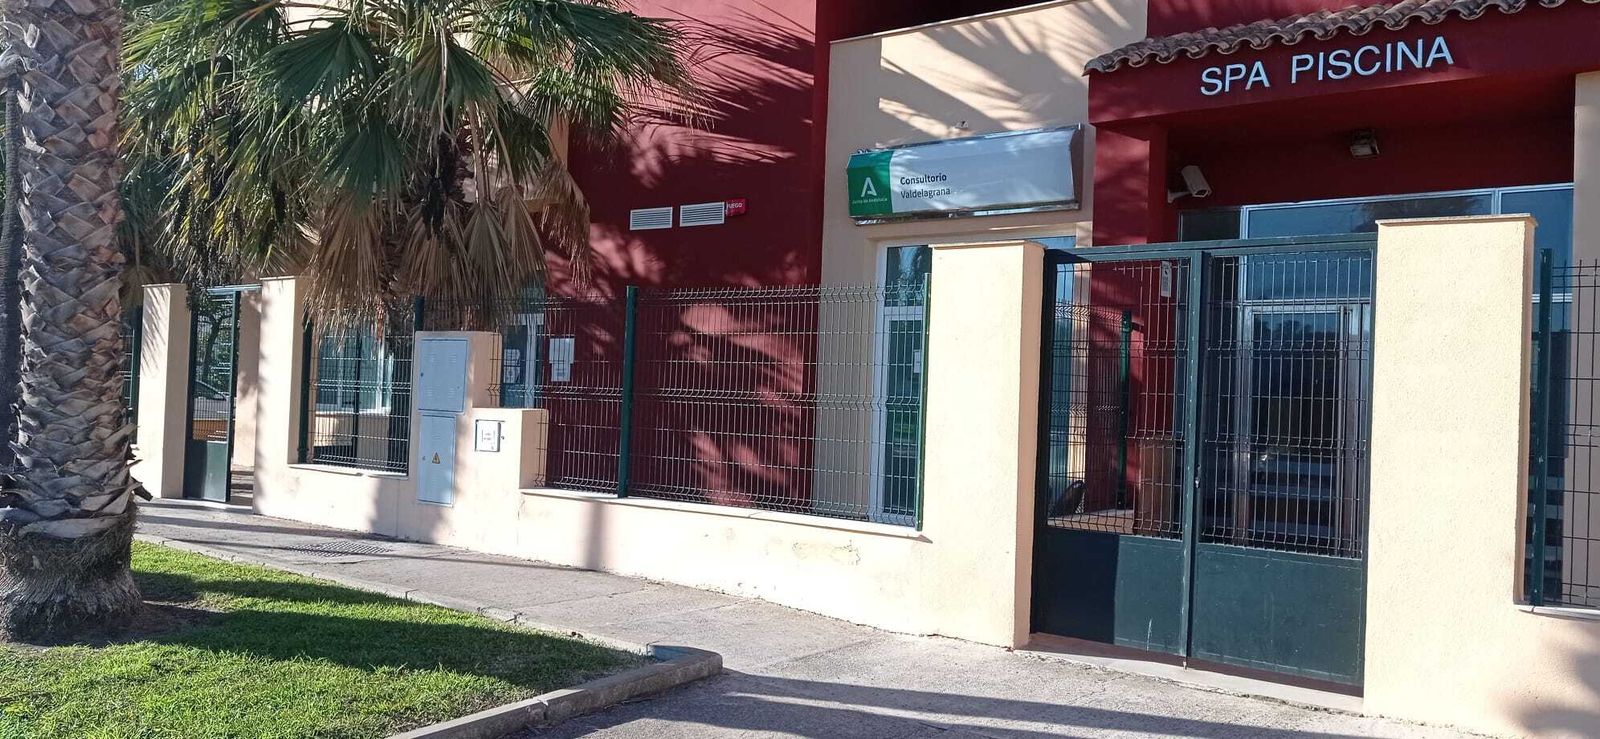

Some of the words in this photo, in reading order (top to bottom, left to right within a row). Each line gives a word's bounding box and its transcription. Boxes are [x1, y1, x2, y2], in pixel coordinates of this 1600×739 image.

[1200, 60, 1270, 96] SPA
[1291, 36, 1454, 84] PISCINA
[900, 172, 947, 185] Consultorio
[900, 187, 951, 199] Valdelagrana
